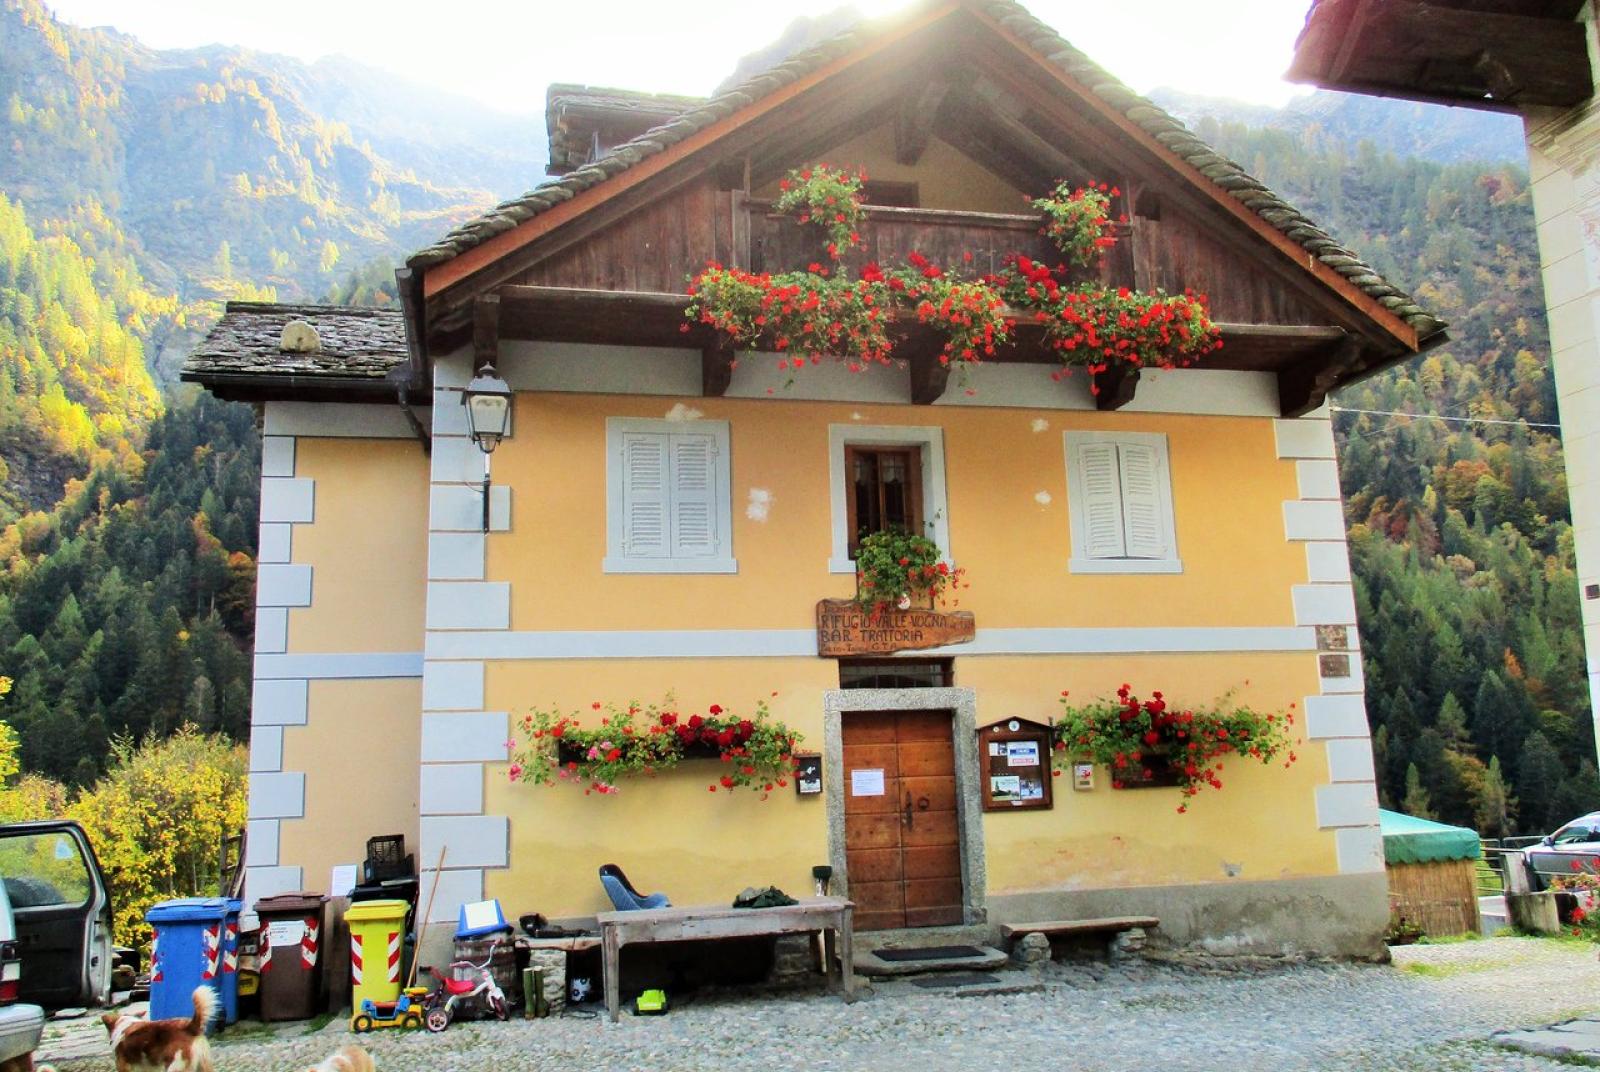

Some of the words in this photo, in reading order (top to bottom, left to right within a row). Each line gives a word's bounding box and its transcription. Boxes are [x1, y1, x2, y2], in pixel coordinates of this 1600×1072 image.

[820, 615, 871, 629] RIFUGIO
[875, 615, 907, 628] VALLE
[911, 615, 947, 628] VOGNA
[820, 630, 851, 643] BAR
[859, 630, 924, 642] TRATTORIA
